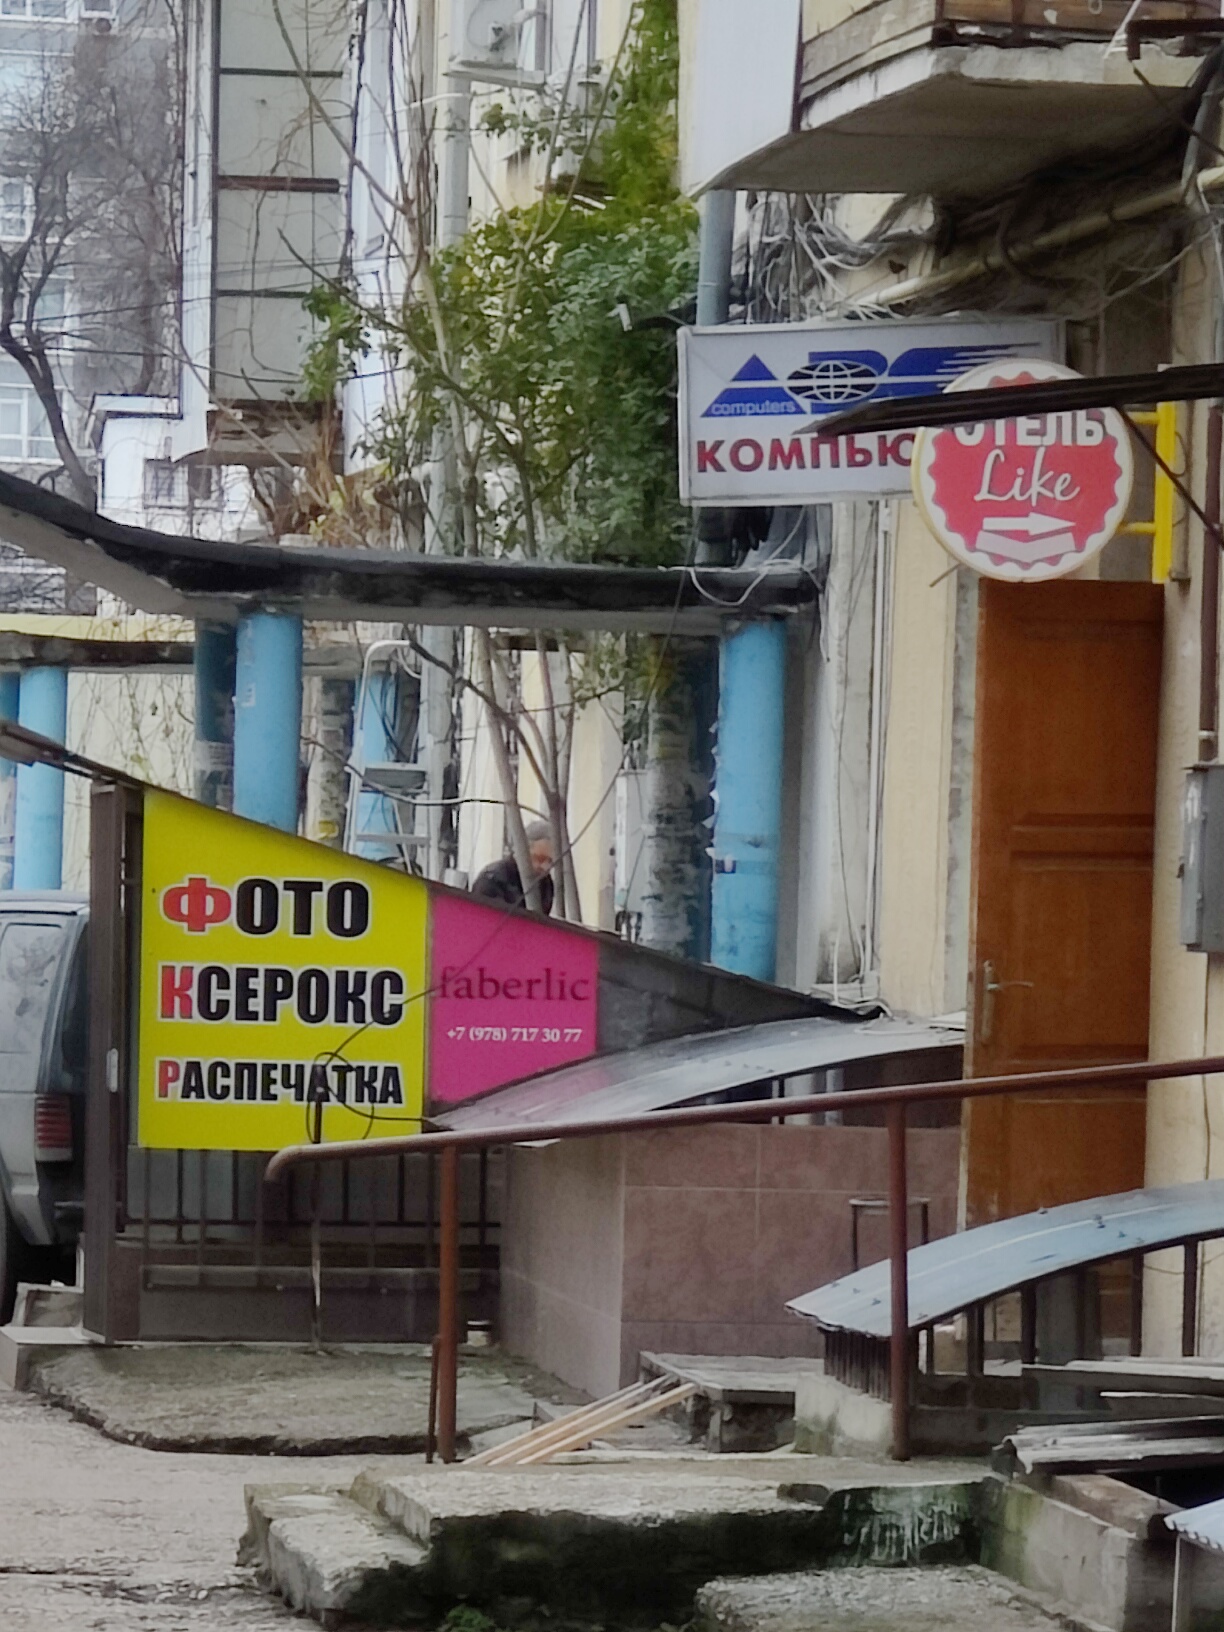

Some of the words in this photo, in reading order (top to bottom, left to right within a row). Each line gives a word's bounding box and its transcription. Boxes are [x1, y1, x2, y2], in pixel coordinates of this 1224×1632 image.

[711, 400, 796, 415] computers
[974, 447, 1081, 507] Like
[162, 877, 369, 938] ФОТО
[160, 965, 404, 1026] КСЕРОКС
[438, 966, 590, 1001] faberlic
[447, 1026, 466, 1041] +7
[469, 1026, 507, 1042] (978)
[511, 1028, 539, 1042] 717
[541, 1028, 561, 1042] 30
[563, 1028, 583, 1042] 77
[158, 1060, 404, 1105] РАСПЕЧАТКА
